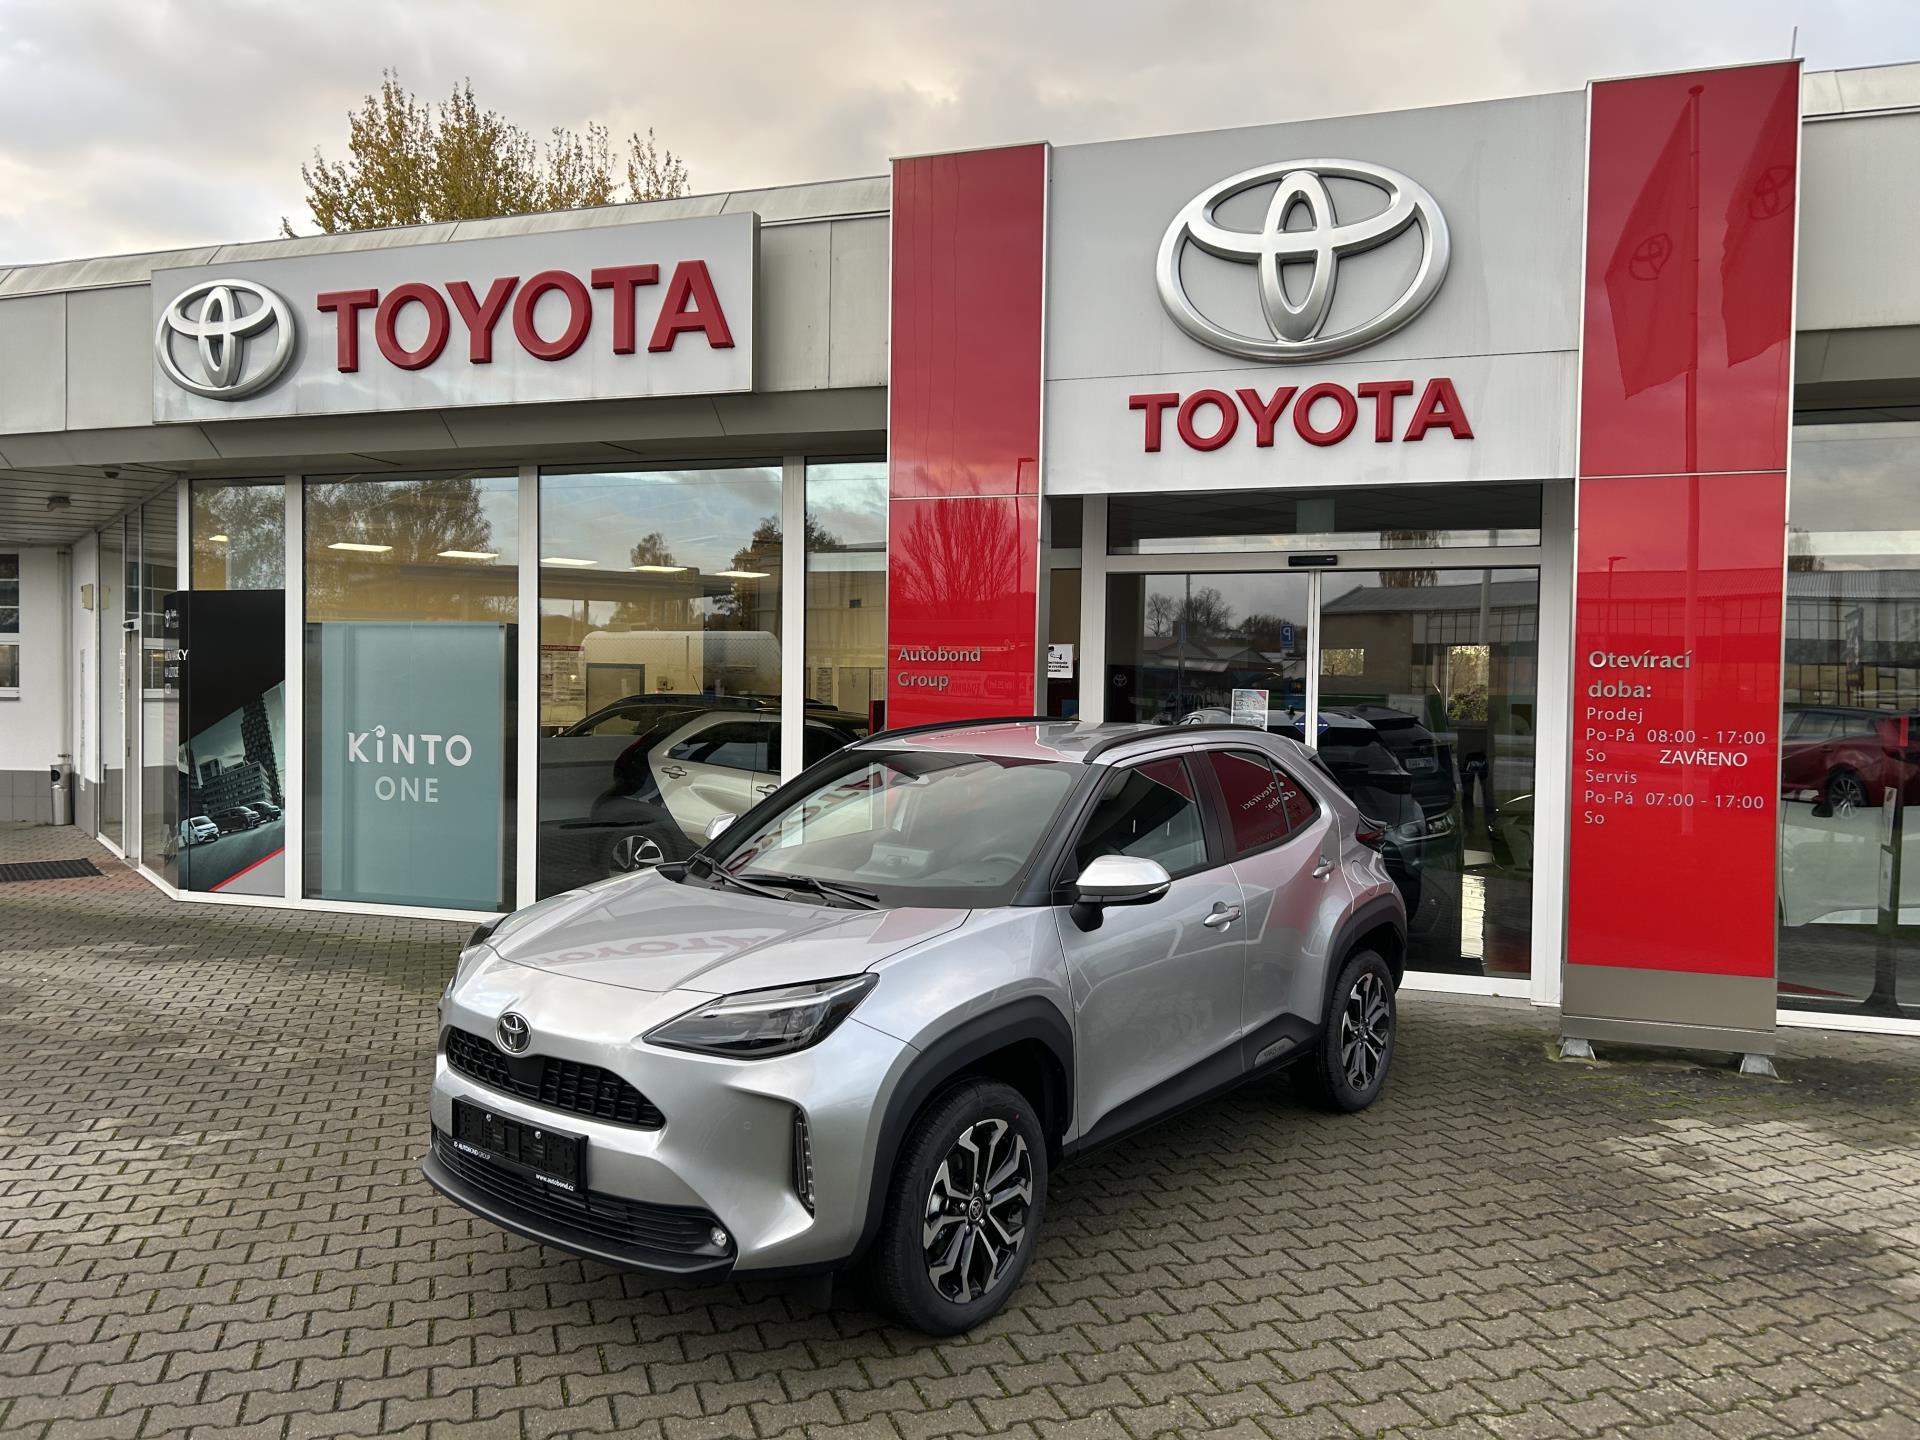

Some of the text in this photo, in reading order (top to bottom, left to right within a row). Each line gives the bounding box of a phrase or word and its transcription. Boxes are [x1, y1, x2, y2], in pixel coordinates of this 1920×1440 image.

[317, 259, 735, 374] TOYOTA
[1128, 377, 1475, 453] TOYOTA
[898, 646, 981, 662] Autobond
[1588, 650, 1692, 669] Otevírací
[897, 672, 949, 691] Group
[1588, 680, 1652, 698] doba:
[1586, 707, 1643, 723] Prodej
[1586, 728, 1635, 742] Po-Pá
[1647, 729, 1696, 744] 08:00
[1716, 731, 1766, 745] 17:00
[1585, 748, 1748, 767] So ZAVŘENO
[1585, 770, 1637, 784] Servis
[375, 776, 439, 803] ONE
[1584, 790, 1633, 805] Po-Pá
[1645, 793, 1694, 807] 07:00
[1714, 795, 1764, 809] 17:00
[1584, 811, 1605, 824] So
